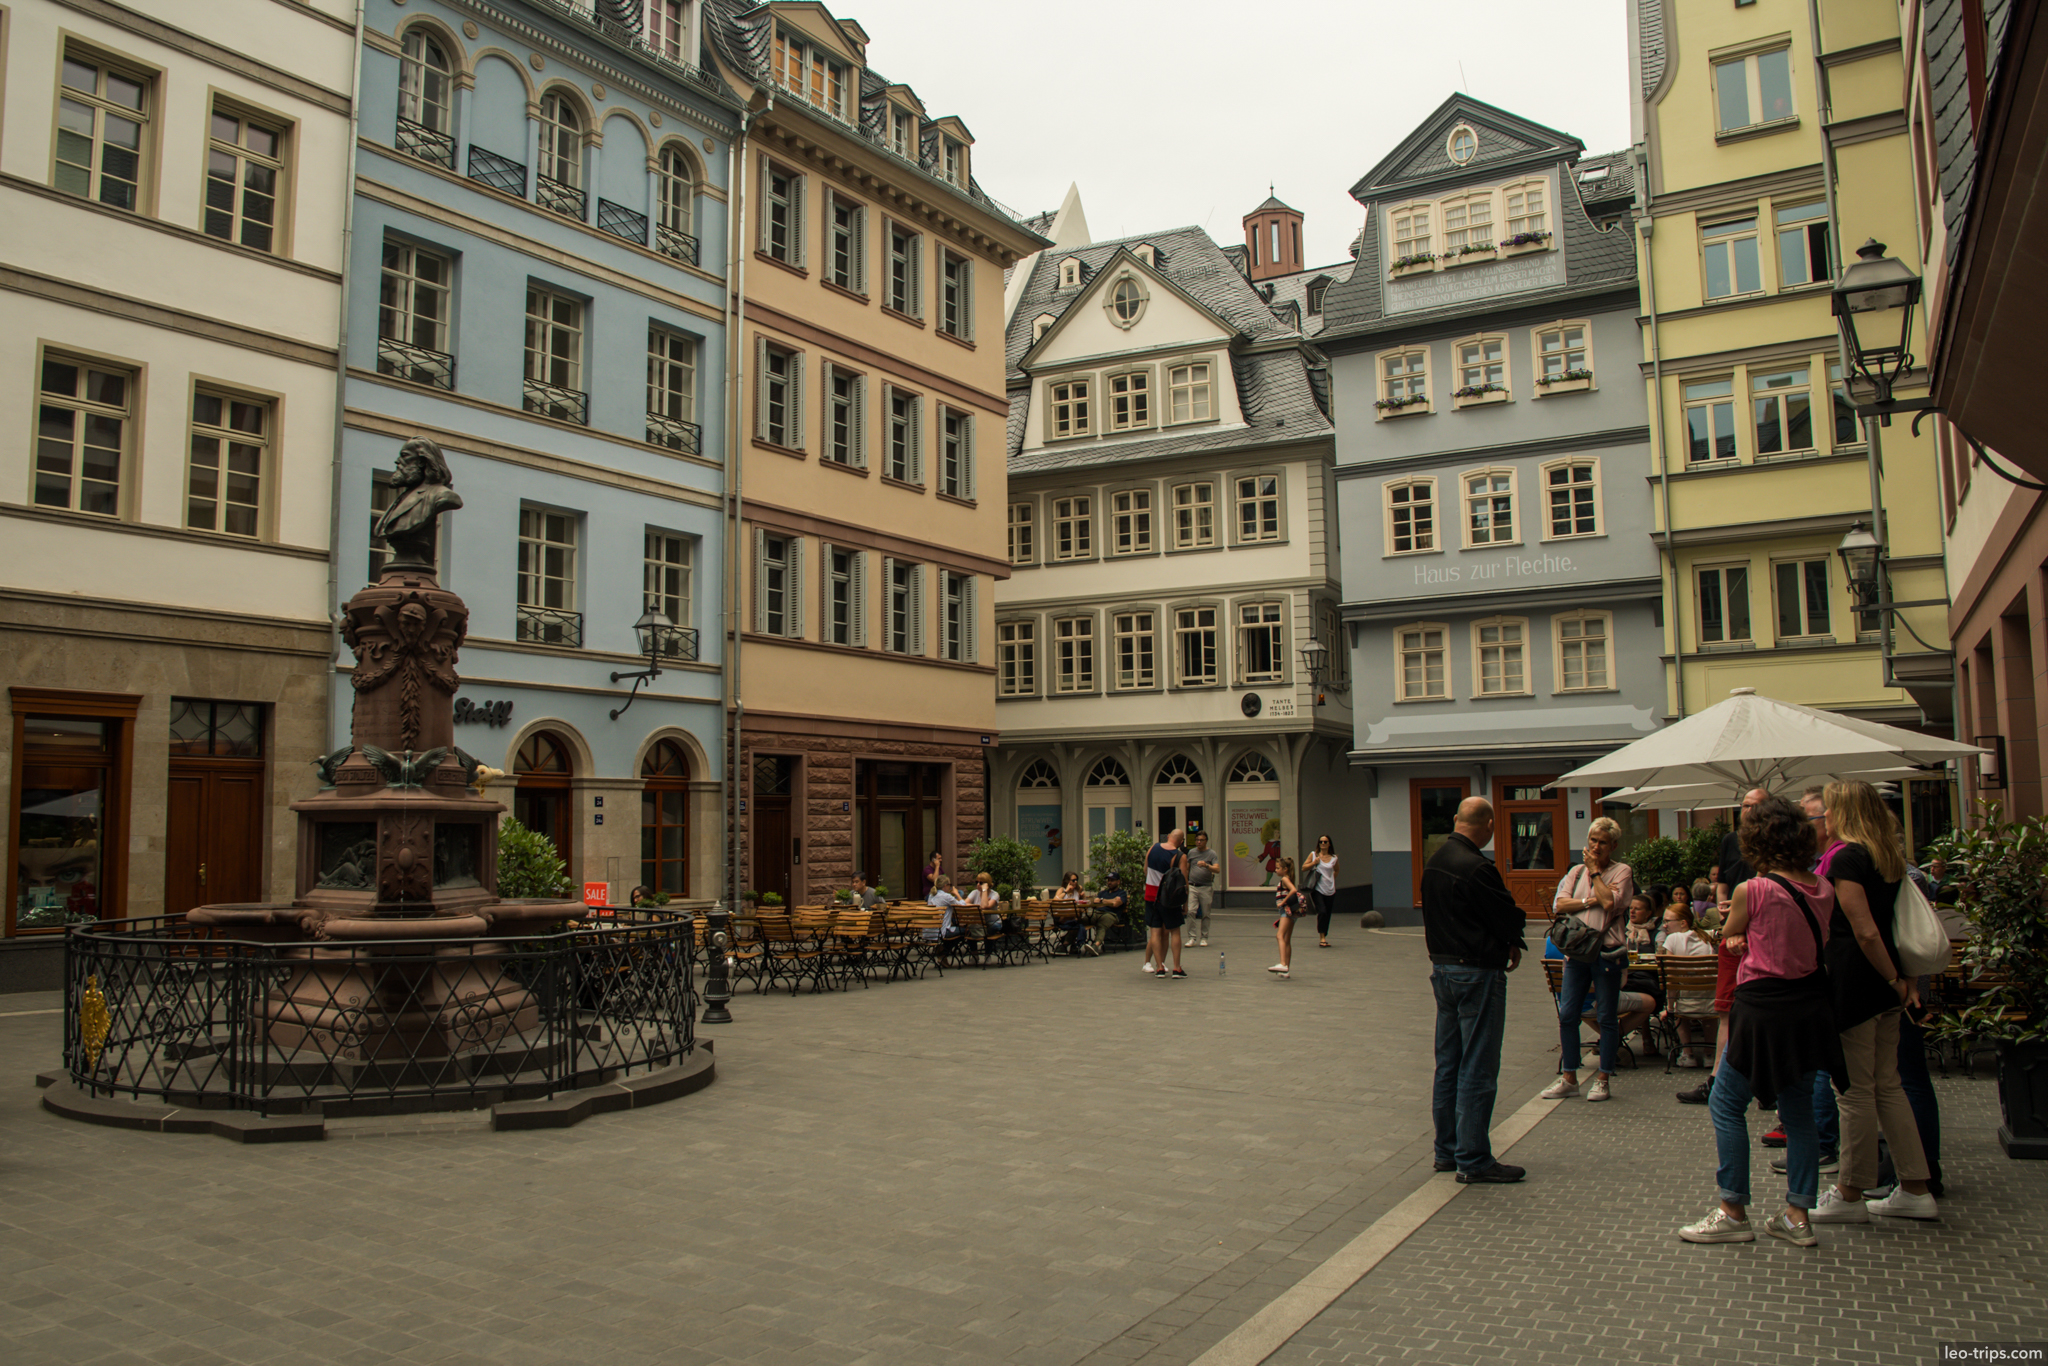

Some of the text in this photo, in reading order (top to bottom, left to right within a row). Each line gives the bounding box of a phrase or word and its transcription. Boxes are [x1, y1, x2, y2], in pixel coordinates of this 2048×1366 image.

[1390, 255, 1556, 293] FRANKFURT LIEGT AM MAINESSTRAND AM
[1390, 265, 1557, 302] RHEINESSTRAND LIEGT WESEL ZUM BESSER MACHEN
[1415, 293, 1450, 306] VERSTAND
[1495, 282, 1515, 293] KANN
[1515, 277, 1538, 289] JEDER
[1539, 274, 1558, 285] ESEL
[1414, 553, 1578, 585] Haus zur Flechte.
[453, 697, 514, 728] Steiff
[586, 888, 606, 900] SALE
